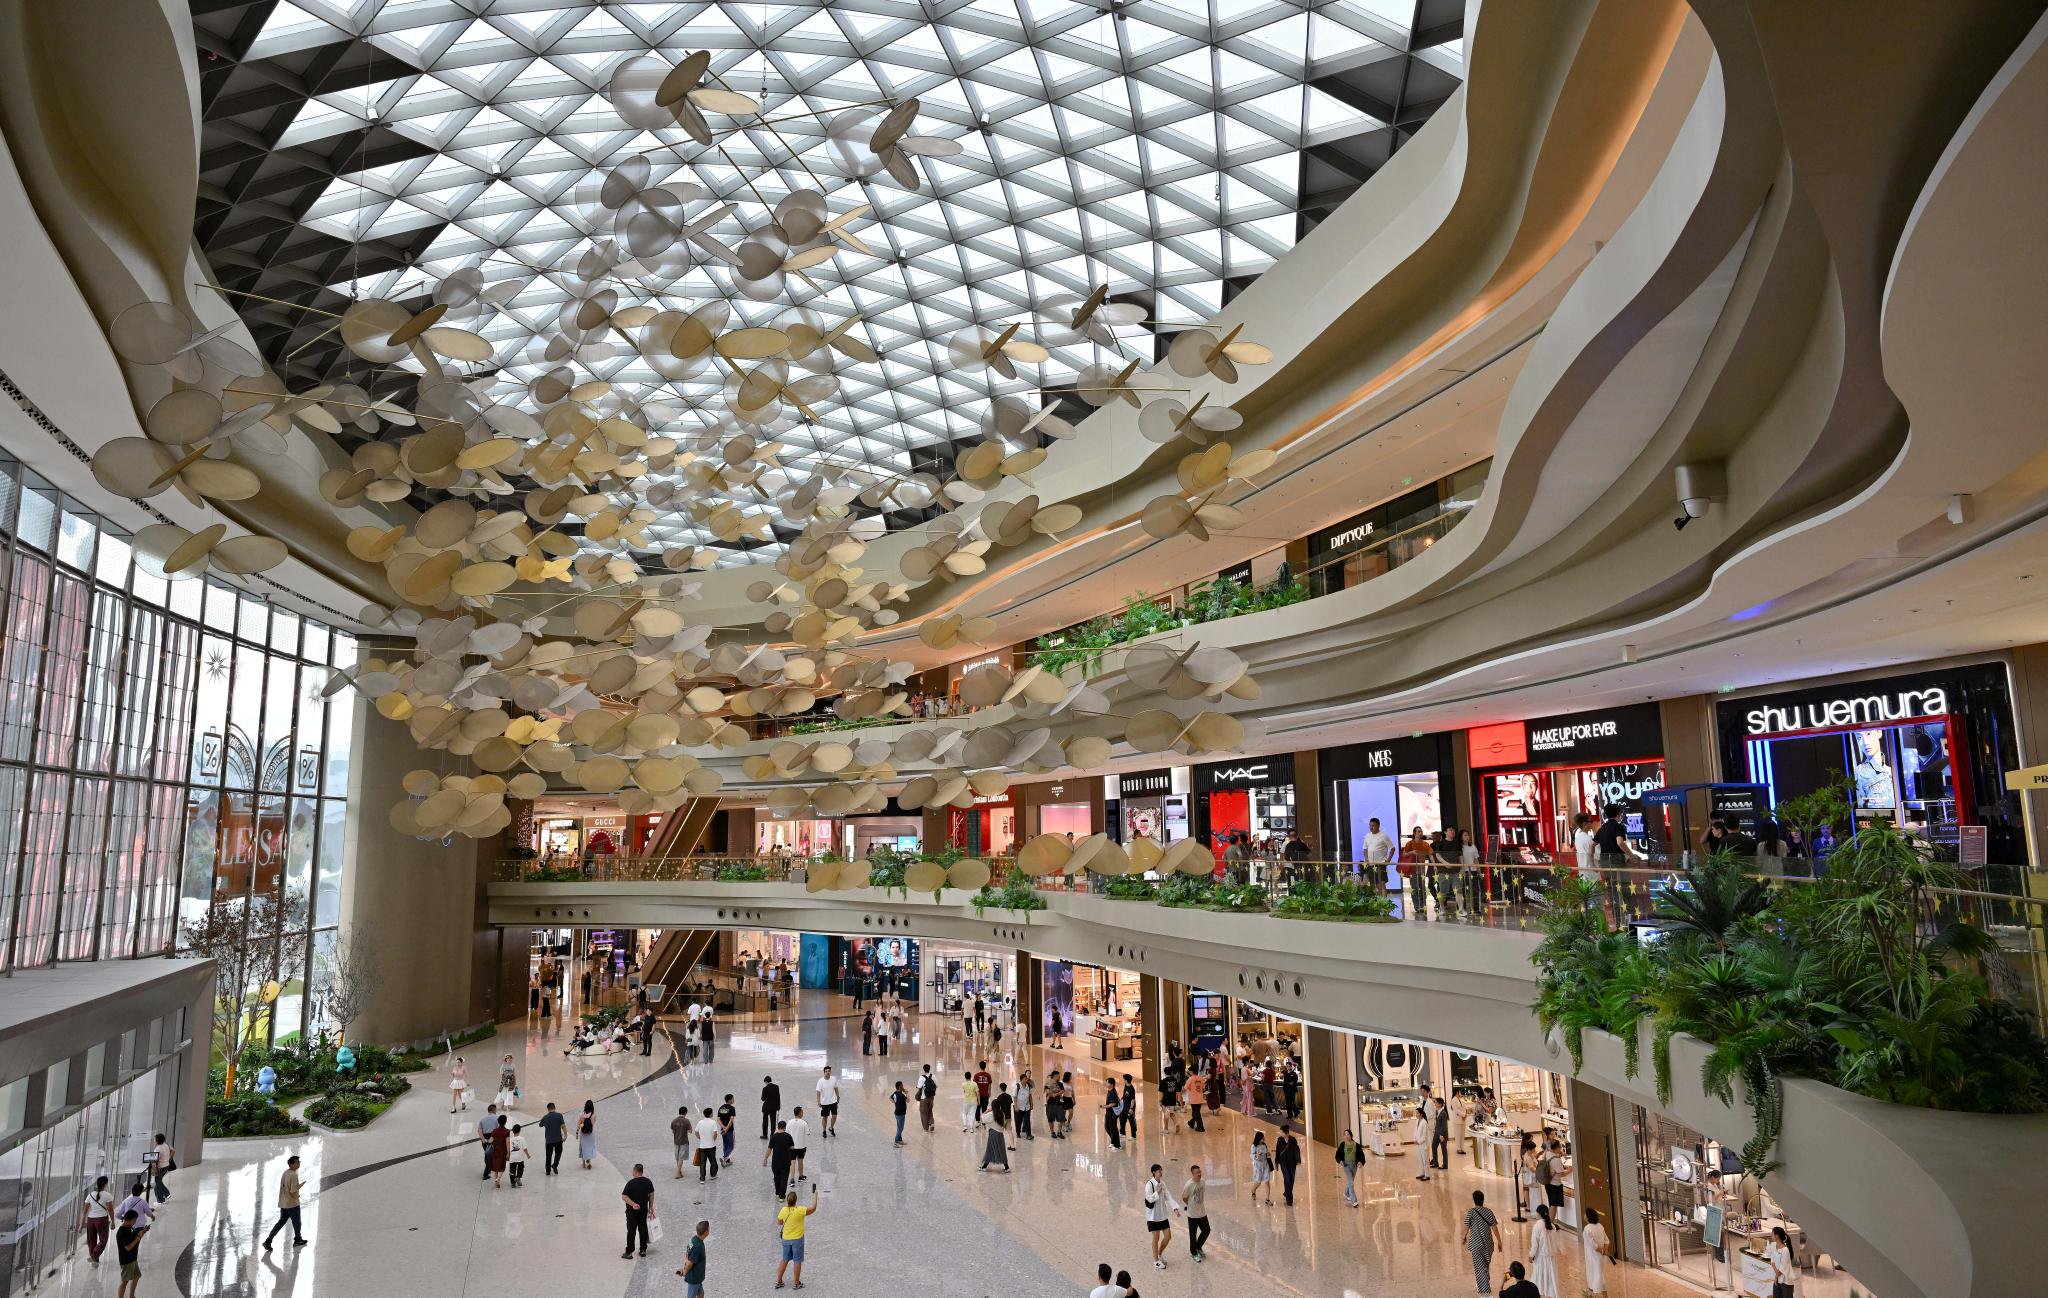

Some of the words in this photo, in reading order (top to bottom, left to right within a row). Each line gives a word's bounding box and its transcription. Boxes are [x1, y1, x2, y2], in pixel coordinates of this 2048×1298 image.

[1330, 521, 1374, 550] DIPTYQUE
[1747, 705, 1800, 734] shu
[1809, 687, 1947, 728] uemura
[1532, 730, 1559, 744] MAKE
[1559, 728, 1572, 742] UP
[1572, 725, 1592, 740] FOR
[1592, 721, 1618, 738] EVER
[1368, 749, 1393, 769] NARS
[1122, 778, 1143, 792] BOBBI
[1145, 776, 1169, 790] BROWN
[594, 818, 615, 826] GUCCI
